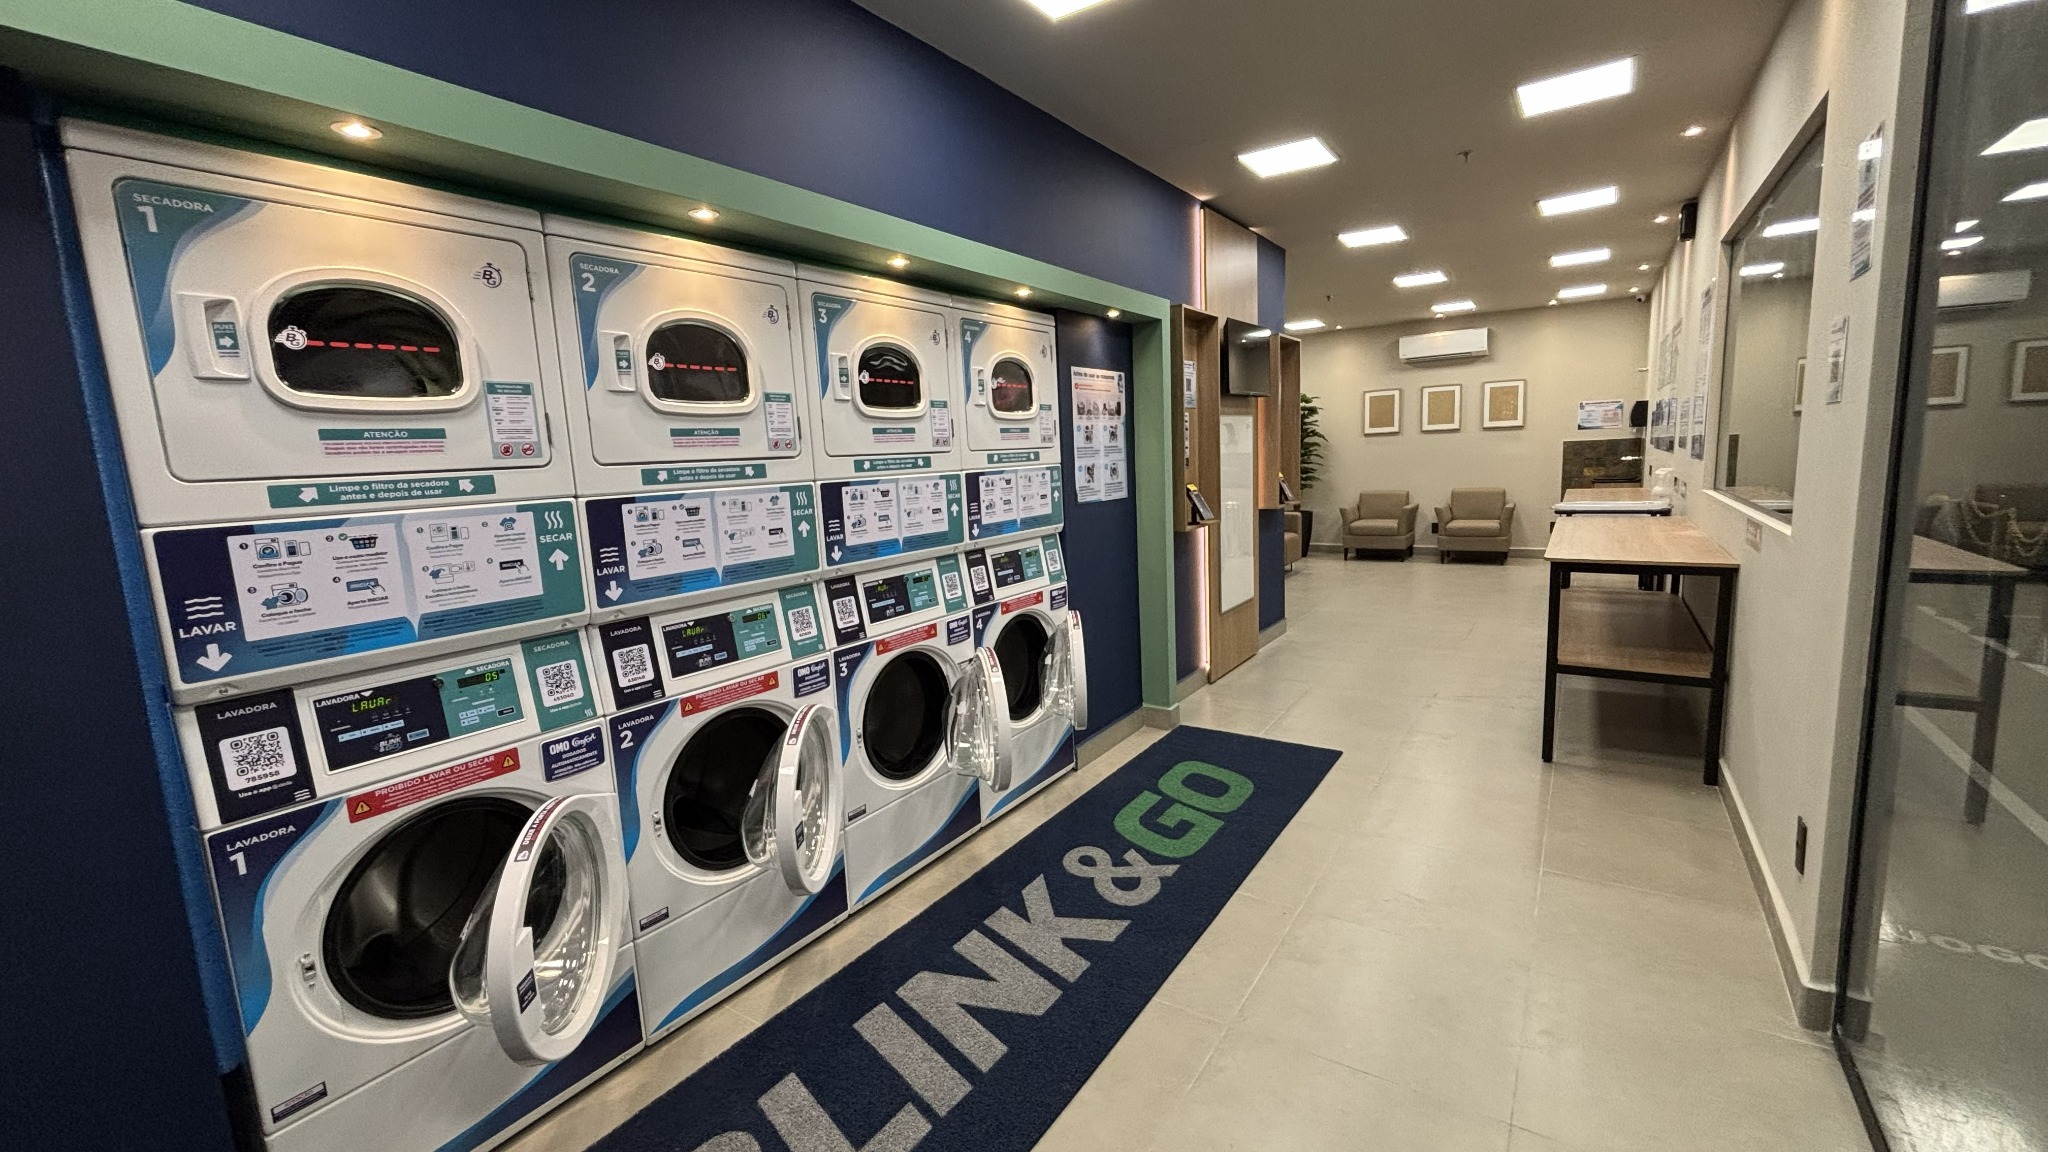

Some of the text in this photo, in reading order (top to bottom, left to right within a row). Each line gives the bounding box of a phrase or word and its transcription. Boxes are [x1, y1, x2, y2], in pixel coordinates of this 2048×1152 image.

[133, 193, 214, 213] SECADORA
[137, 205, 158, 233] 1
[580, 262, 619, 274] SECADORA
[581, 272, 596, 292] 2
[818, 308, 827, 324] 3
[965, 331, 972, 343] 4
[363, 429, 409, 438] ATENÇÃO
[693, 428, 720, 436] ATENÇÃO
[328, 485, 360, 493] Limpe
[371, 482, 394, 490] filtro
[396, 481, 408, 489] da
[340, 492, 367, 501] antes
[377, 490, 409, 499] depois
[793, 508, 813, 517] SECAR
[539, 533, 573, 543] SECAR
[826, 534, 845, 542] LAVAR
[596, 565, 626, 576] LAVAR
[179, 621, 237, 639] LAVAR
[610, 625, 642, 636] LAVADORA
[976, 618, 983, 630] 4
[533, 640, 570, 653] SECADORA
[838, 652, 861, 662] LAVADORA
[476, 660, 510, 673] SECADORA
[797, 666, 810, 677] OMO
[839, 662, 848, 677] 3
[695, 688, 722, 700] PROIBIDO
[722, 682, 739, 693] LAVAR
[748, 675, 765, 686] SECAR
[316, 694, 360, 708] LAVADORA
[216, 702, 278, 720] LAVADORA
[618, 714, 655, 730] LAVADORA
[619, 730, 634, 749] 2
[549, 741, 570, 755] OMO
[375, 755, 495, 797] PROIBIDO LAVAR OU SECAR
[226, 825, 296, 851] LAVADORA
[229, 851, 247, 876] 1
